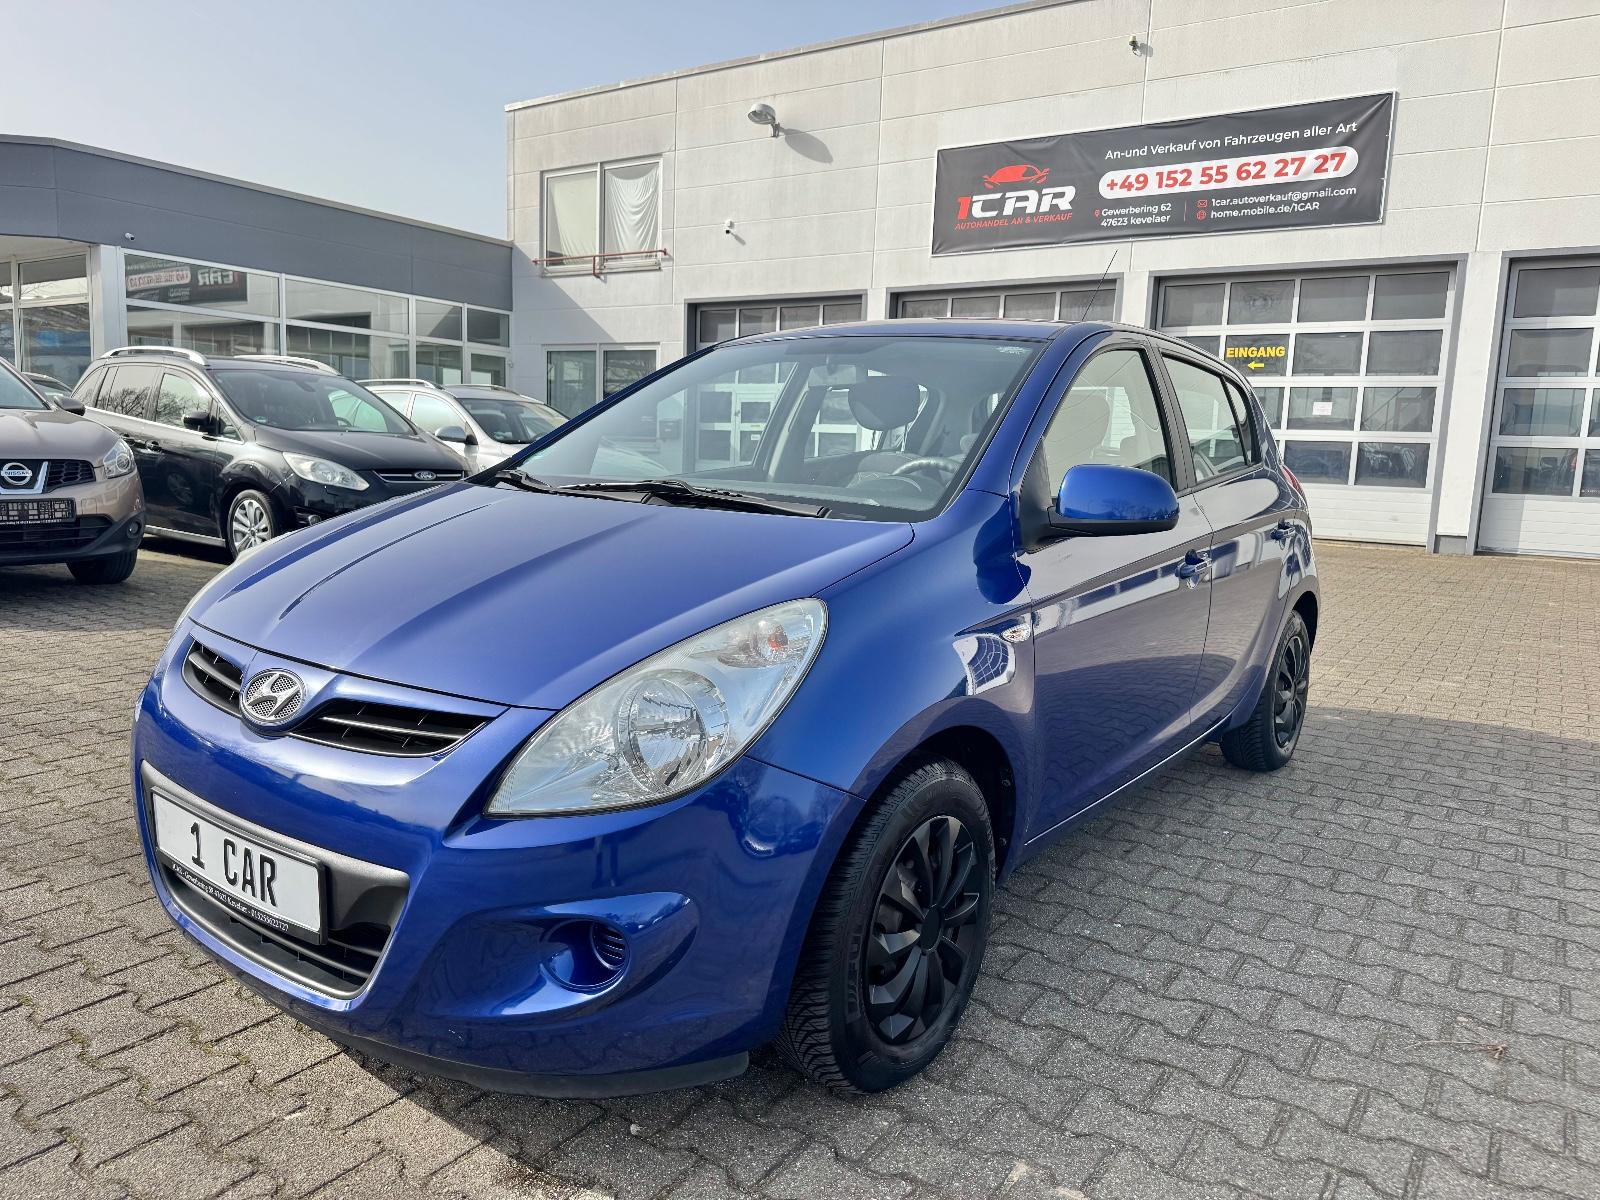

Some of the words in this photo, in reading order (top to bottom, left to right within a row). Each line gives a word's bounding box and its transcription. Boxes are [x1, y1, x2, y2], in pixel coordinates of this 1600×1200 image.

[1105, 145, 1148, 160] An-und
[1150, 139, 1197, 155] Verkauf
[1199, 138, 1221, 149] von
[1224, 129, 1300, 147] Fahrzeugen
[1303, 125, 1332, 138] aller
[1335, 121, 1358, 134] Art
[1106, 173, 1149, 192] +49
[1155, 168, 1193, 189] 152
[1199, 164, 1228, 185] 55
[1236, 160, 1267, 181] 62
[1274, 156, 1307, 178] 27
[1313, 152, 1347, 174] 27
[956, 185, 1076, 220] 1CAR
[1211, 187, 1357, 207] 1car.autoverkauf@gmail.com
[1101, 205, 1159, 217] Gewerbering
[1160, 202, 1172, 212] 62
[1210, 201, 1320, 219] home.mobile.de/1CAR
[954, 218, 1009, 231] AUTOHANDEL
[1011, 217, 1024, 225] AN
[1025, 216, 1032, 224] &
[1033, 212, 1073, 224] VERKAUF
[1100, 217, 1128, 227] 47623
[1130, 214, 1171, 225] kevelaer
[1226, 346, 1286, 358] EINGANG
[189, 821, 206, 870] 1
[223, 837, 279, 907] CAR
